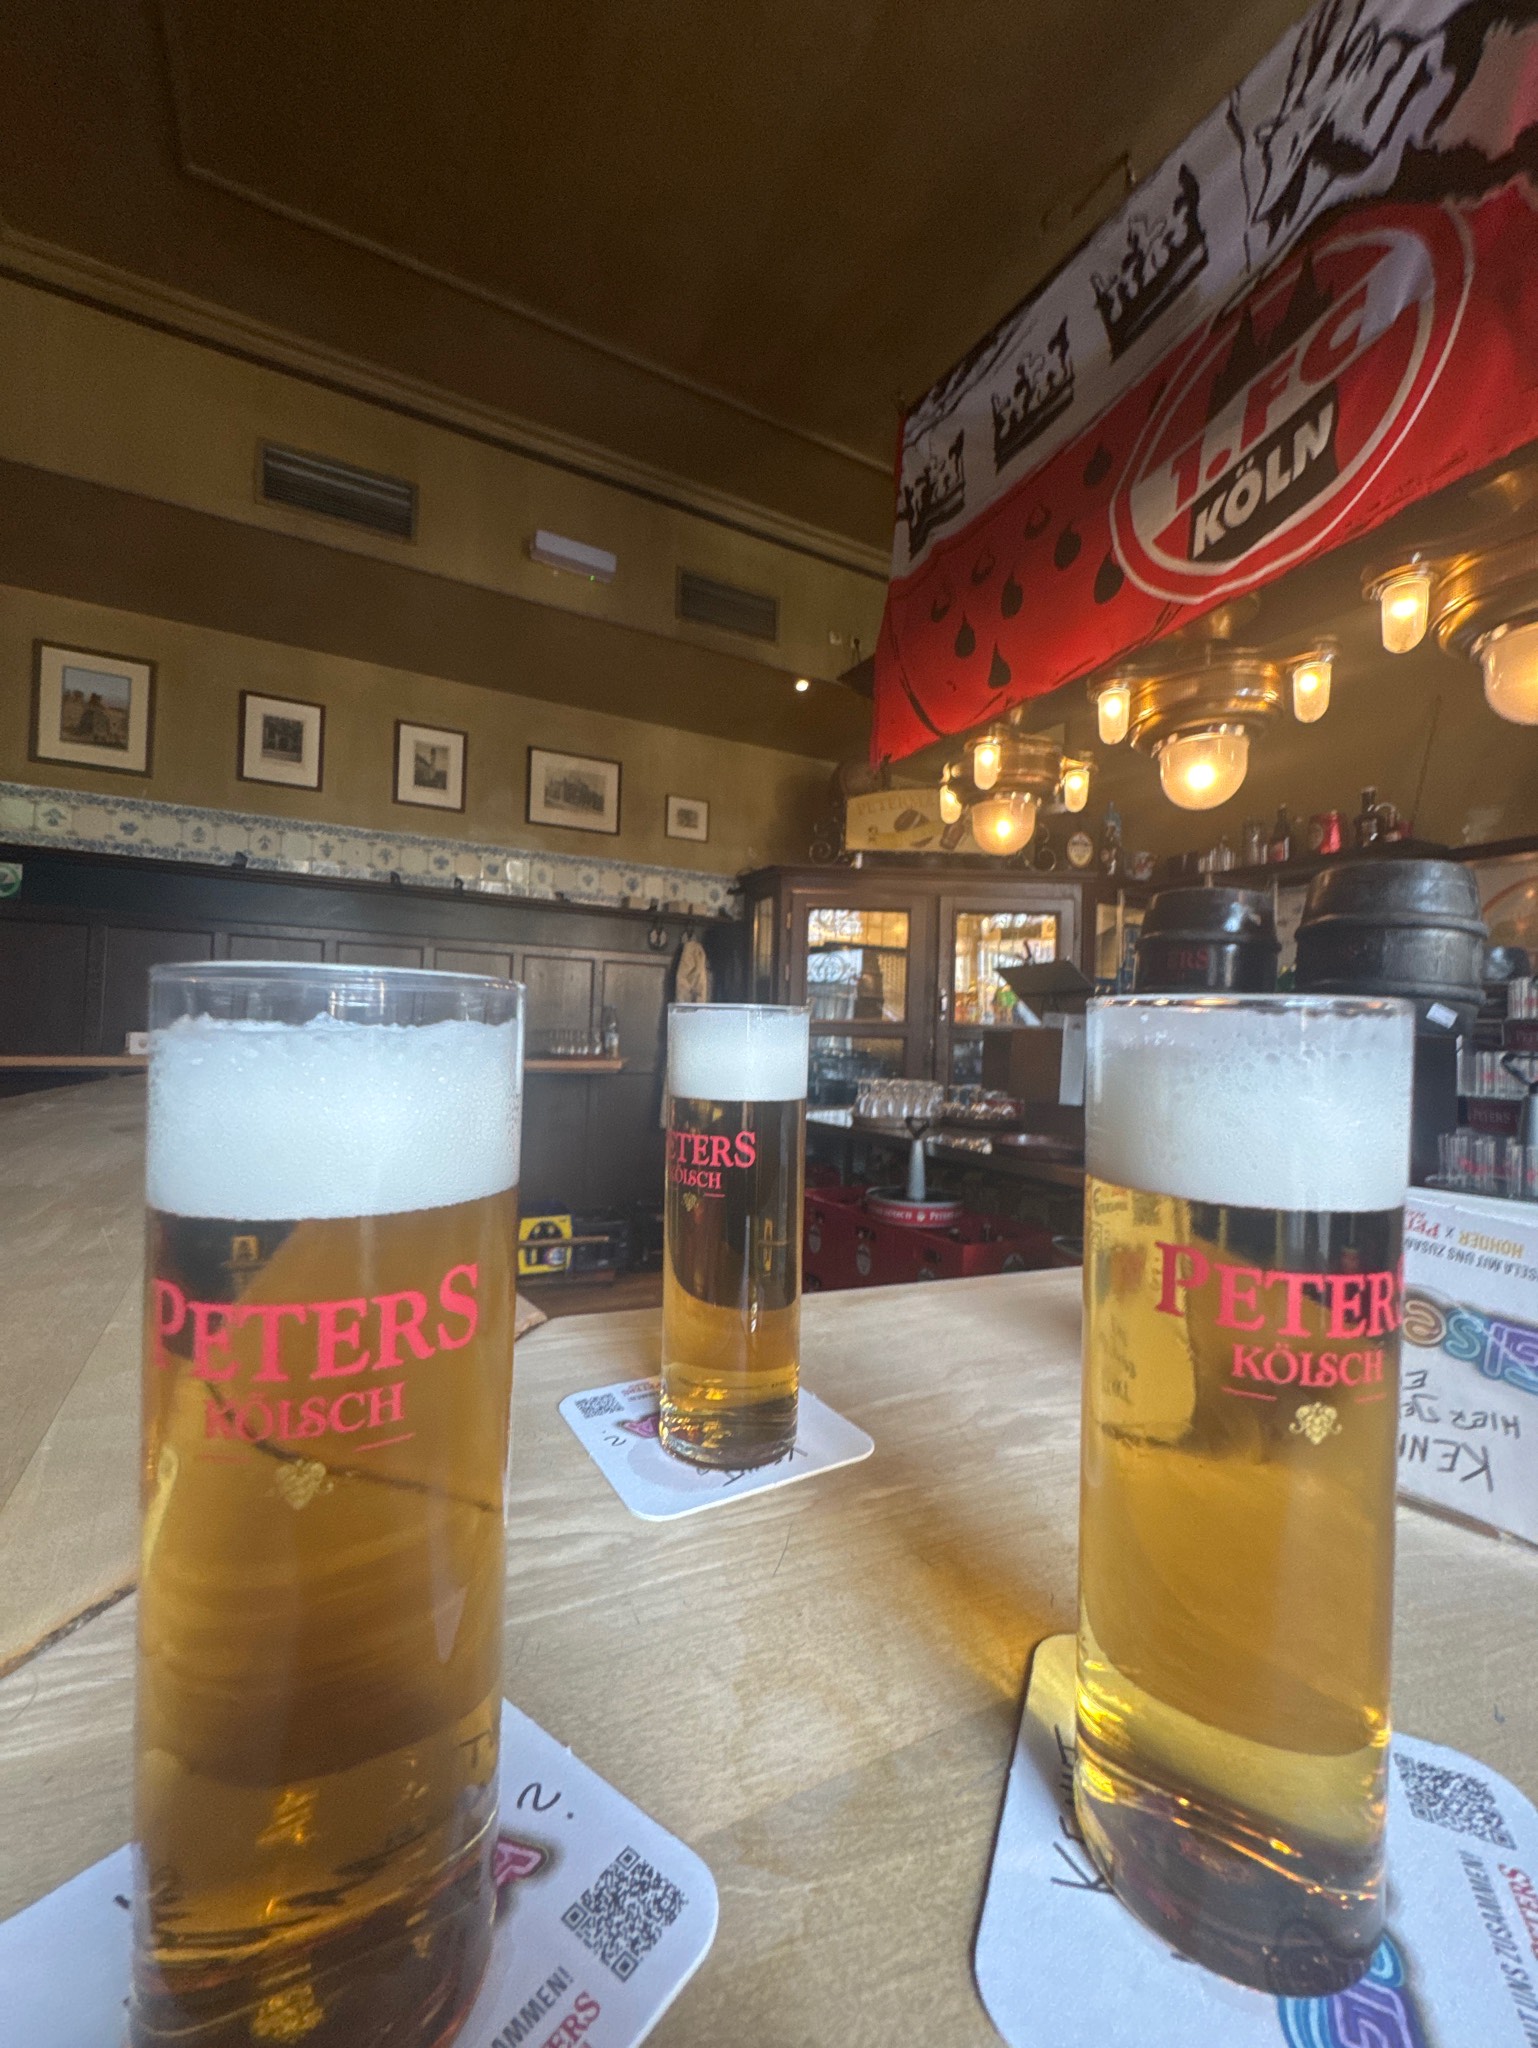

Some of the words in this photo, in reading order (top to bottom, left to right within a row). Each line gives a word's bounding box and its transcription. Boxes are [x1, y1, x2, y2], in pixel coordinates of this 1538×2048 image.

[1193, 402, 1334, 558] KÖLN
[1231, 1342, 1385, 1388] KÖLSCH
[204, 1381, 405, 1441] KÖLSCH
[1448, 1410, 1521, 1440] HIER
